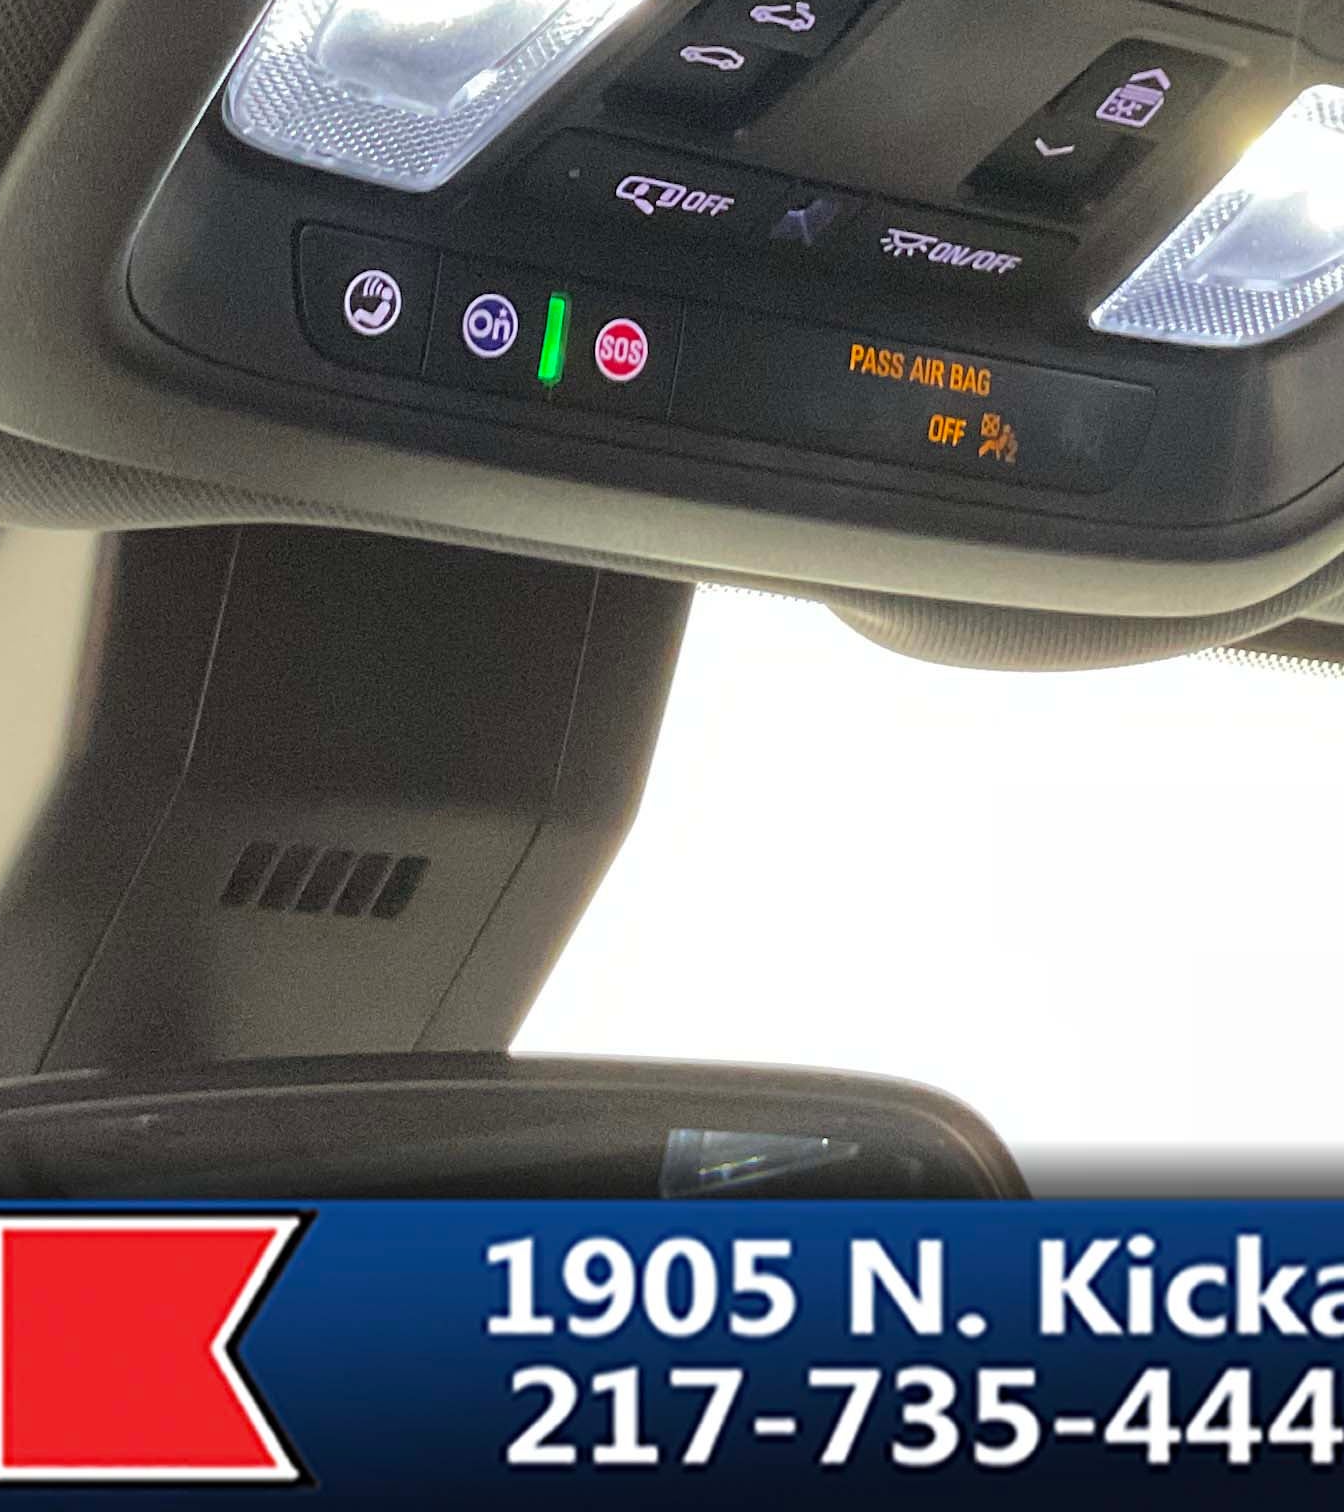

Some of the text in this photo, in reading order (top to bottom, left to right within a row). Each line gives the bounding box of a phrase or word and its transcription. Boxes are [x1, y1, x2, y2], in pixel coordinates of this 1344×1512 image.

[681, 191, 734, 217] OFF
[927, 241, 1022, 275] ON/OFF
[599, 334, 643, 365] SOS
[850, 344, 992, 396] PASS AIR BAG
[928, 414, 966, 445] OFF
